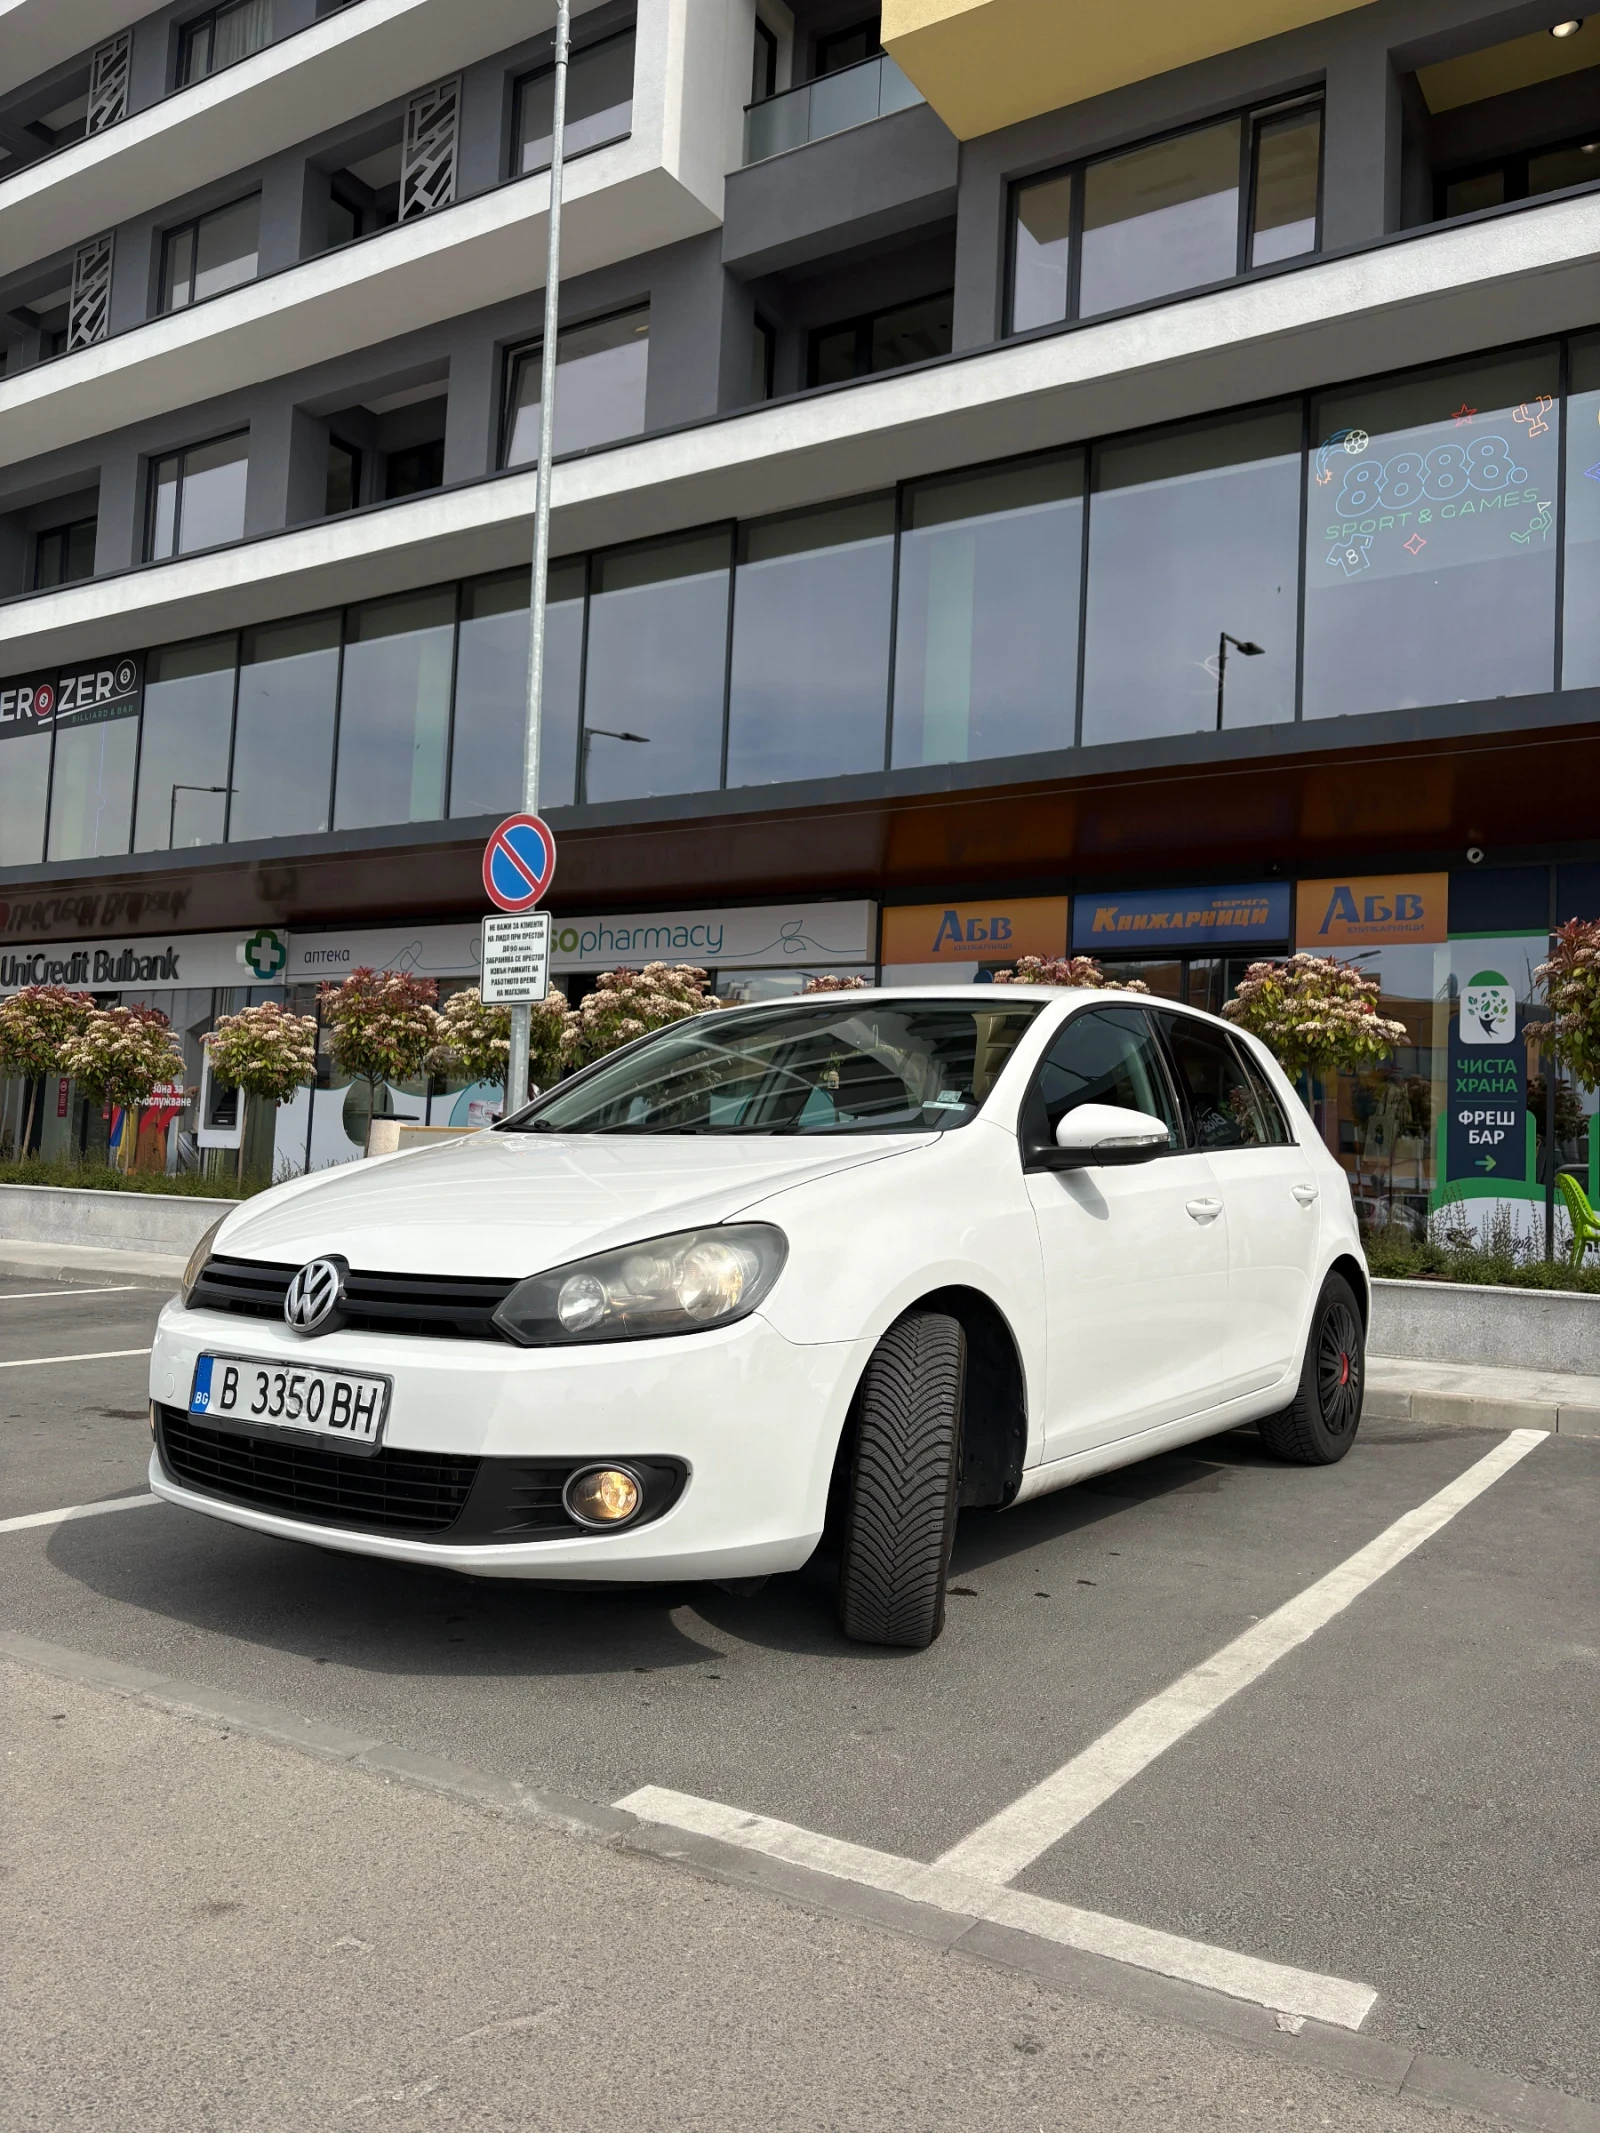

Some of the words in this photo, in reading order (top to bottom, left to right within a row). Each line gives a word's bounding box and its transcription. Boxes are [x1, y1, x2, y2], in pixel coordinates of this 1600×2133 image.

[1325, 512, 1412, 540] SPORT
[1418, 508, 1433, 523] &
[1441, 488, 1540, 518] GAMES
[72, 709, 109, 723] BILLIARD
[110, 709, 115, 717] &
[116, 705, 133, 715] BAR
[1211, 898, 1270, 908] ВЕРИГА
[1318, 886, 1425, 934] АБВ
[490, 923, 496, 931] НЕ
[497, 922, 511, 931] ВАЖИ
[513, 921, 519, 930] ЗА
[521, 920, 543, 929] КЛИЕНТИ
[931, 909, 1013, 952] АБВ
[495, 934, 510, 942] ЛИДЛ
[511, 933, 521, 941] ПРИ
[522, 930, 544, 940] ПРЕСТОЙ
[304, 949, 350, 963] аптека
[486, 956, 514, 965] ЗАБРАНЯВА
[0, 951, 90, 986] UniCredit
[92, 946, 180, 983] Bulbank
[490, 967, 506, 975] ИЗВЪН
[508, 965, 531, 973] РАМКИТЕ
[491, 977, 519, 986] РАБОТНОТО
[520, 976, 537, 984] ВРЕМЕ
[505, 988, 530, 996] МАГАЗИНА
[1456, 1058, 1518, 1074] ЧИСТА
[173, 1085, 184, 1094] за
[1455, 1078, 1518, 1093] ХРАНА
[1458, 1109, 1515, 1126] ФРЕШ
[1468, 1129, 1505, 1145] БАР
[194, 1391, 209, 1405] BG
[219, 1366, 240, 1410] B
[251, 1370, 325, 1423] 3350
[328, 1381, 378, 1434] BH
